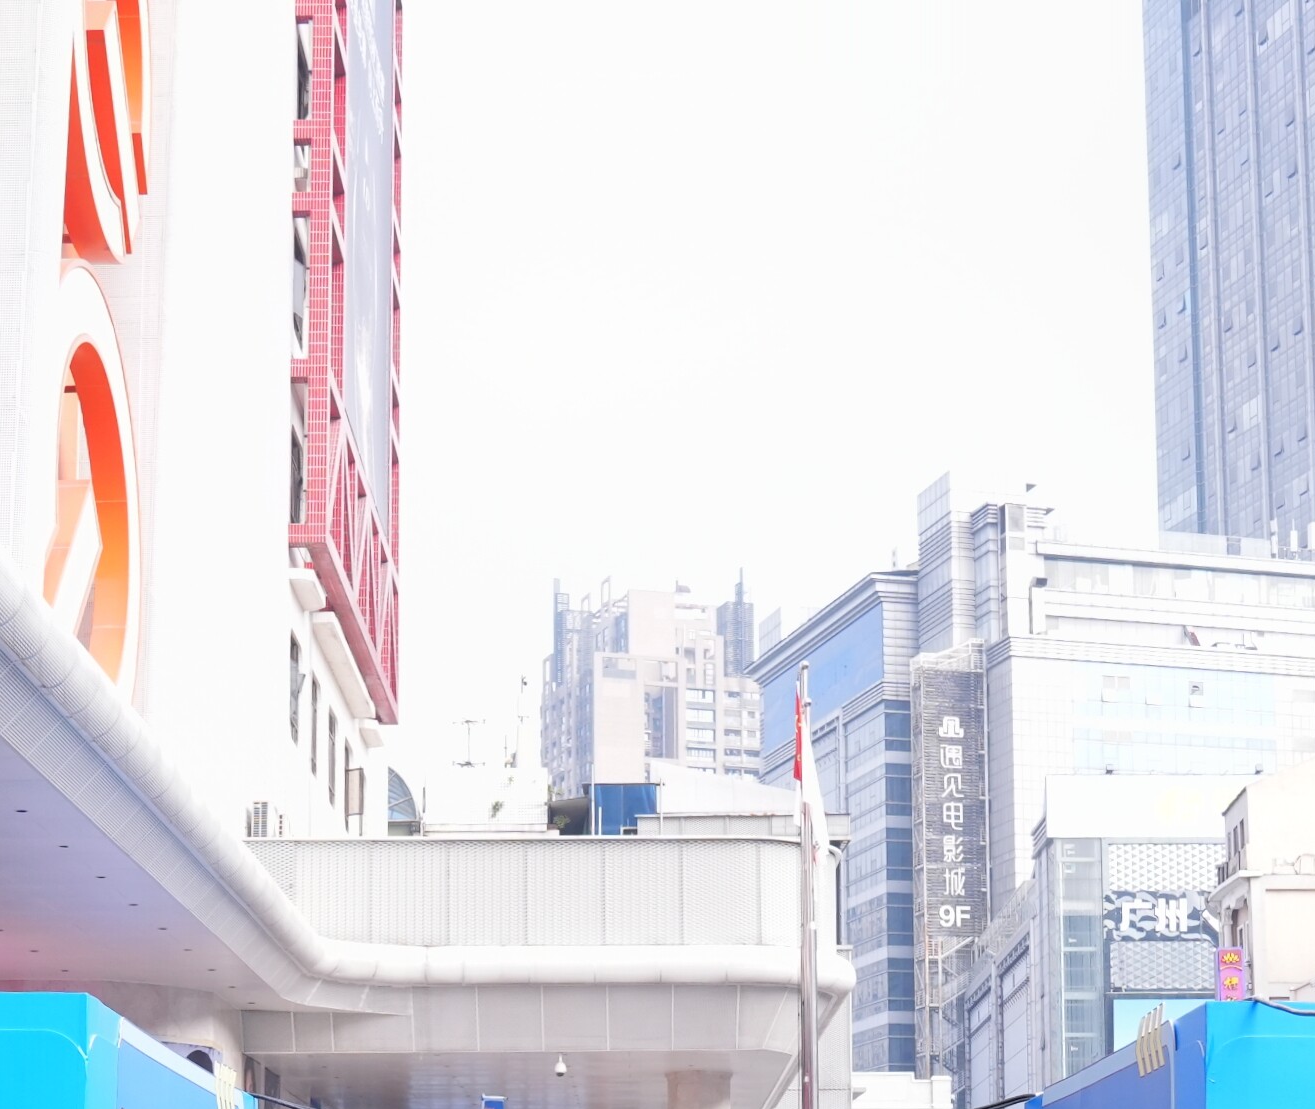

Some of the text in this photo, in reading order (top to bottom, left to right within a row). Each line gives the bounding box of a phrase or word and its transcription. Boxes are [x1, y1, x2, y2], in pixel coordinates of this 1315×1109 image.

[939, 744, 971, 927] 遇见电影城 9F
[1120, 898, 1188, 932] 广州
